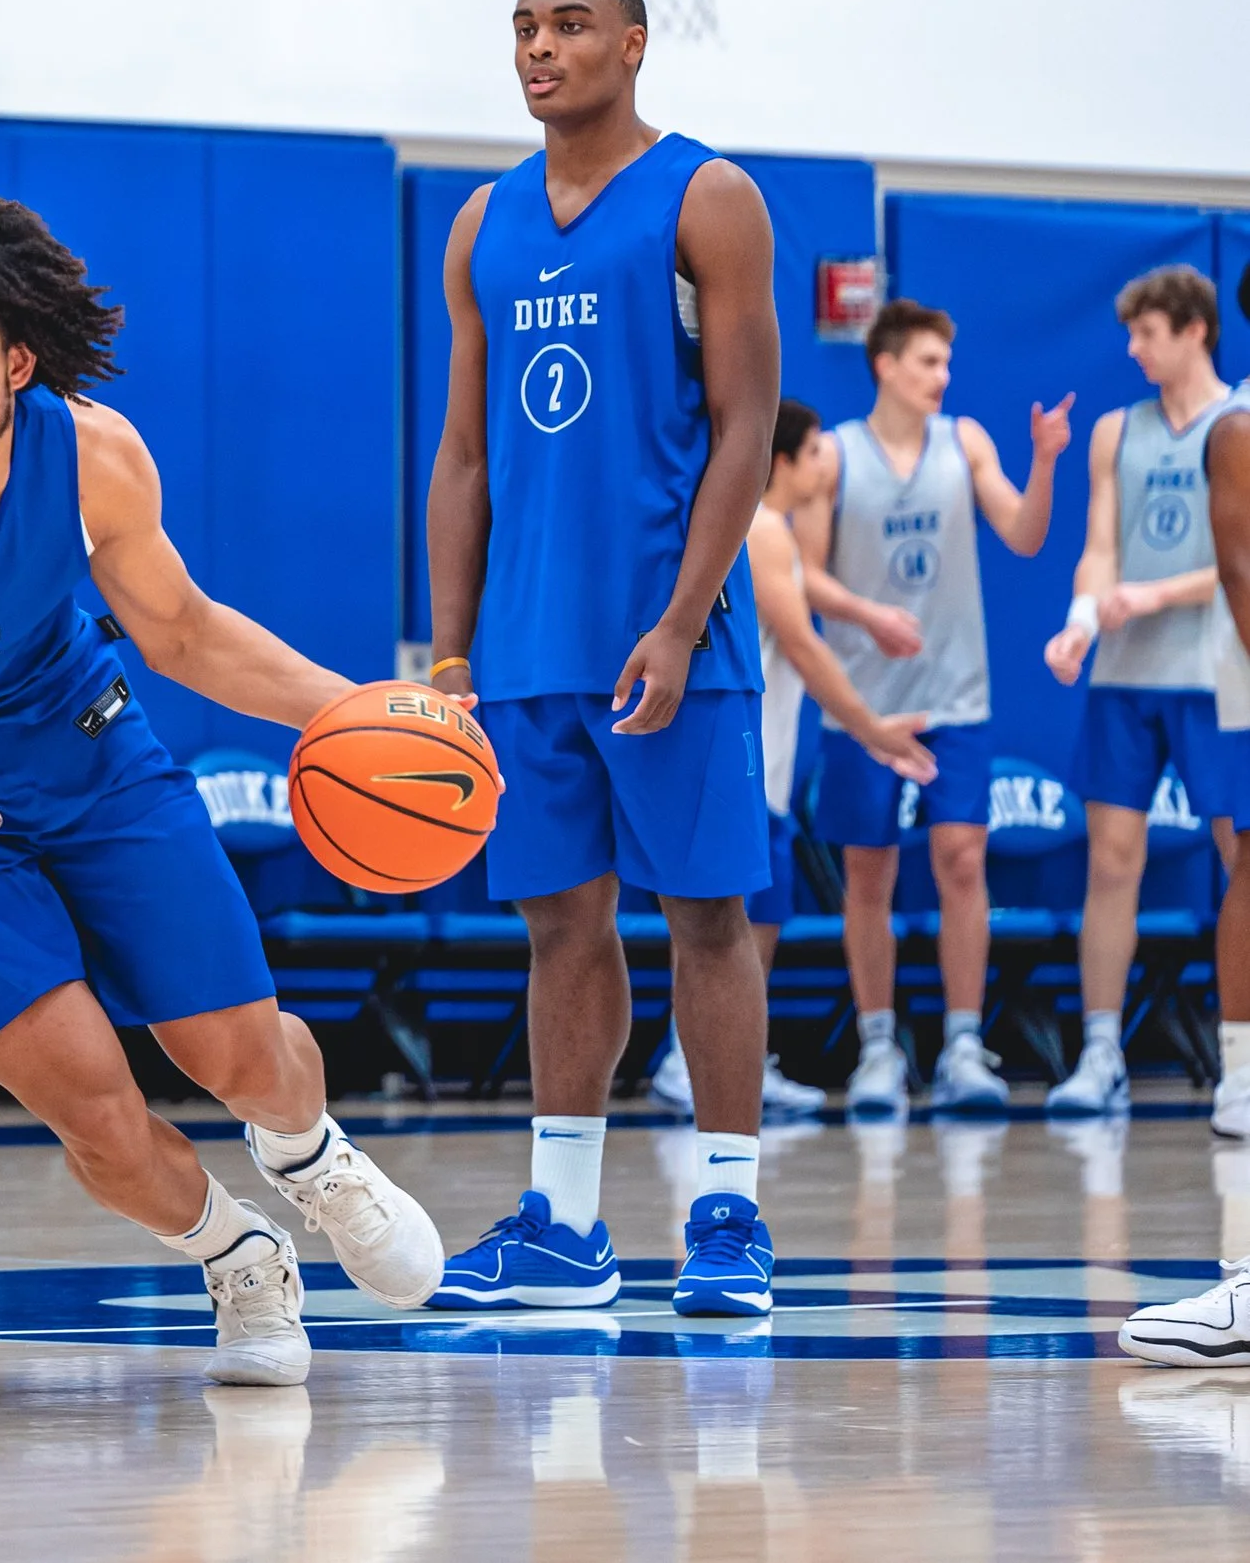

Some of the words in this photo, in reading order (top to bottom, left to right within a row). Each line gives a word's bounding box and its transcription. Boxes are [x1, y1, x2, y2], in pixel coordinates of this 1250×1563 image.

[514, 293, 598, 331] DUKE
[548, 363, 564, 412] 2
[1145, 468, 1197, 492] DUKE
[882, 510, 941, 540] DUKE
[387, 695, 485, 751] ELITE
[990, 776, 1066, 831] UKE
